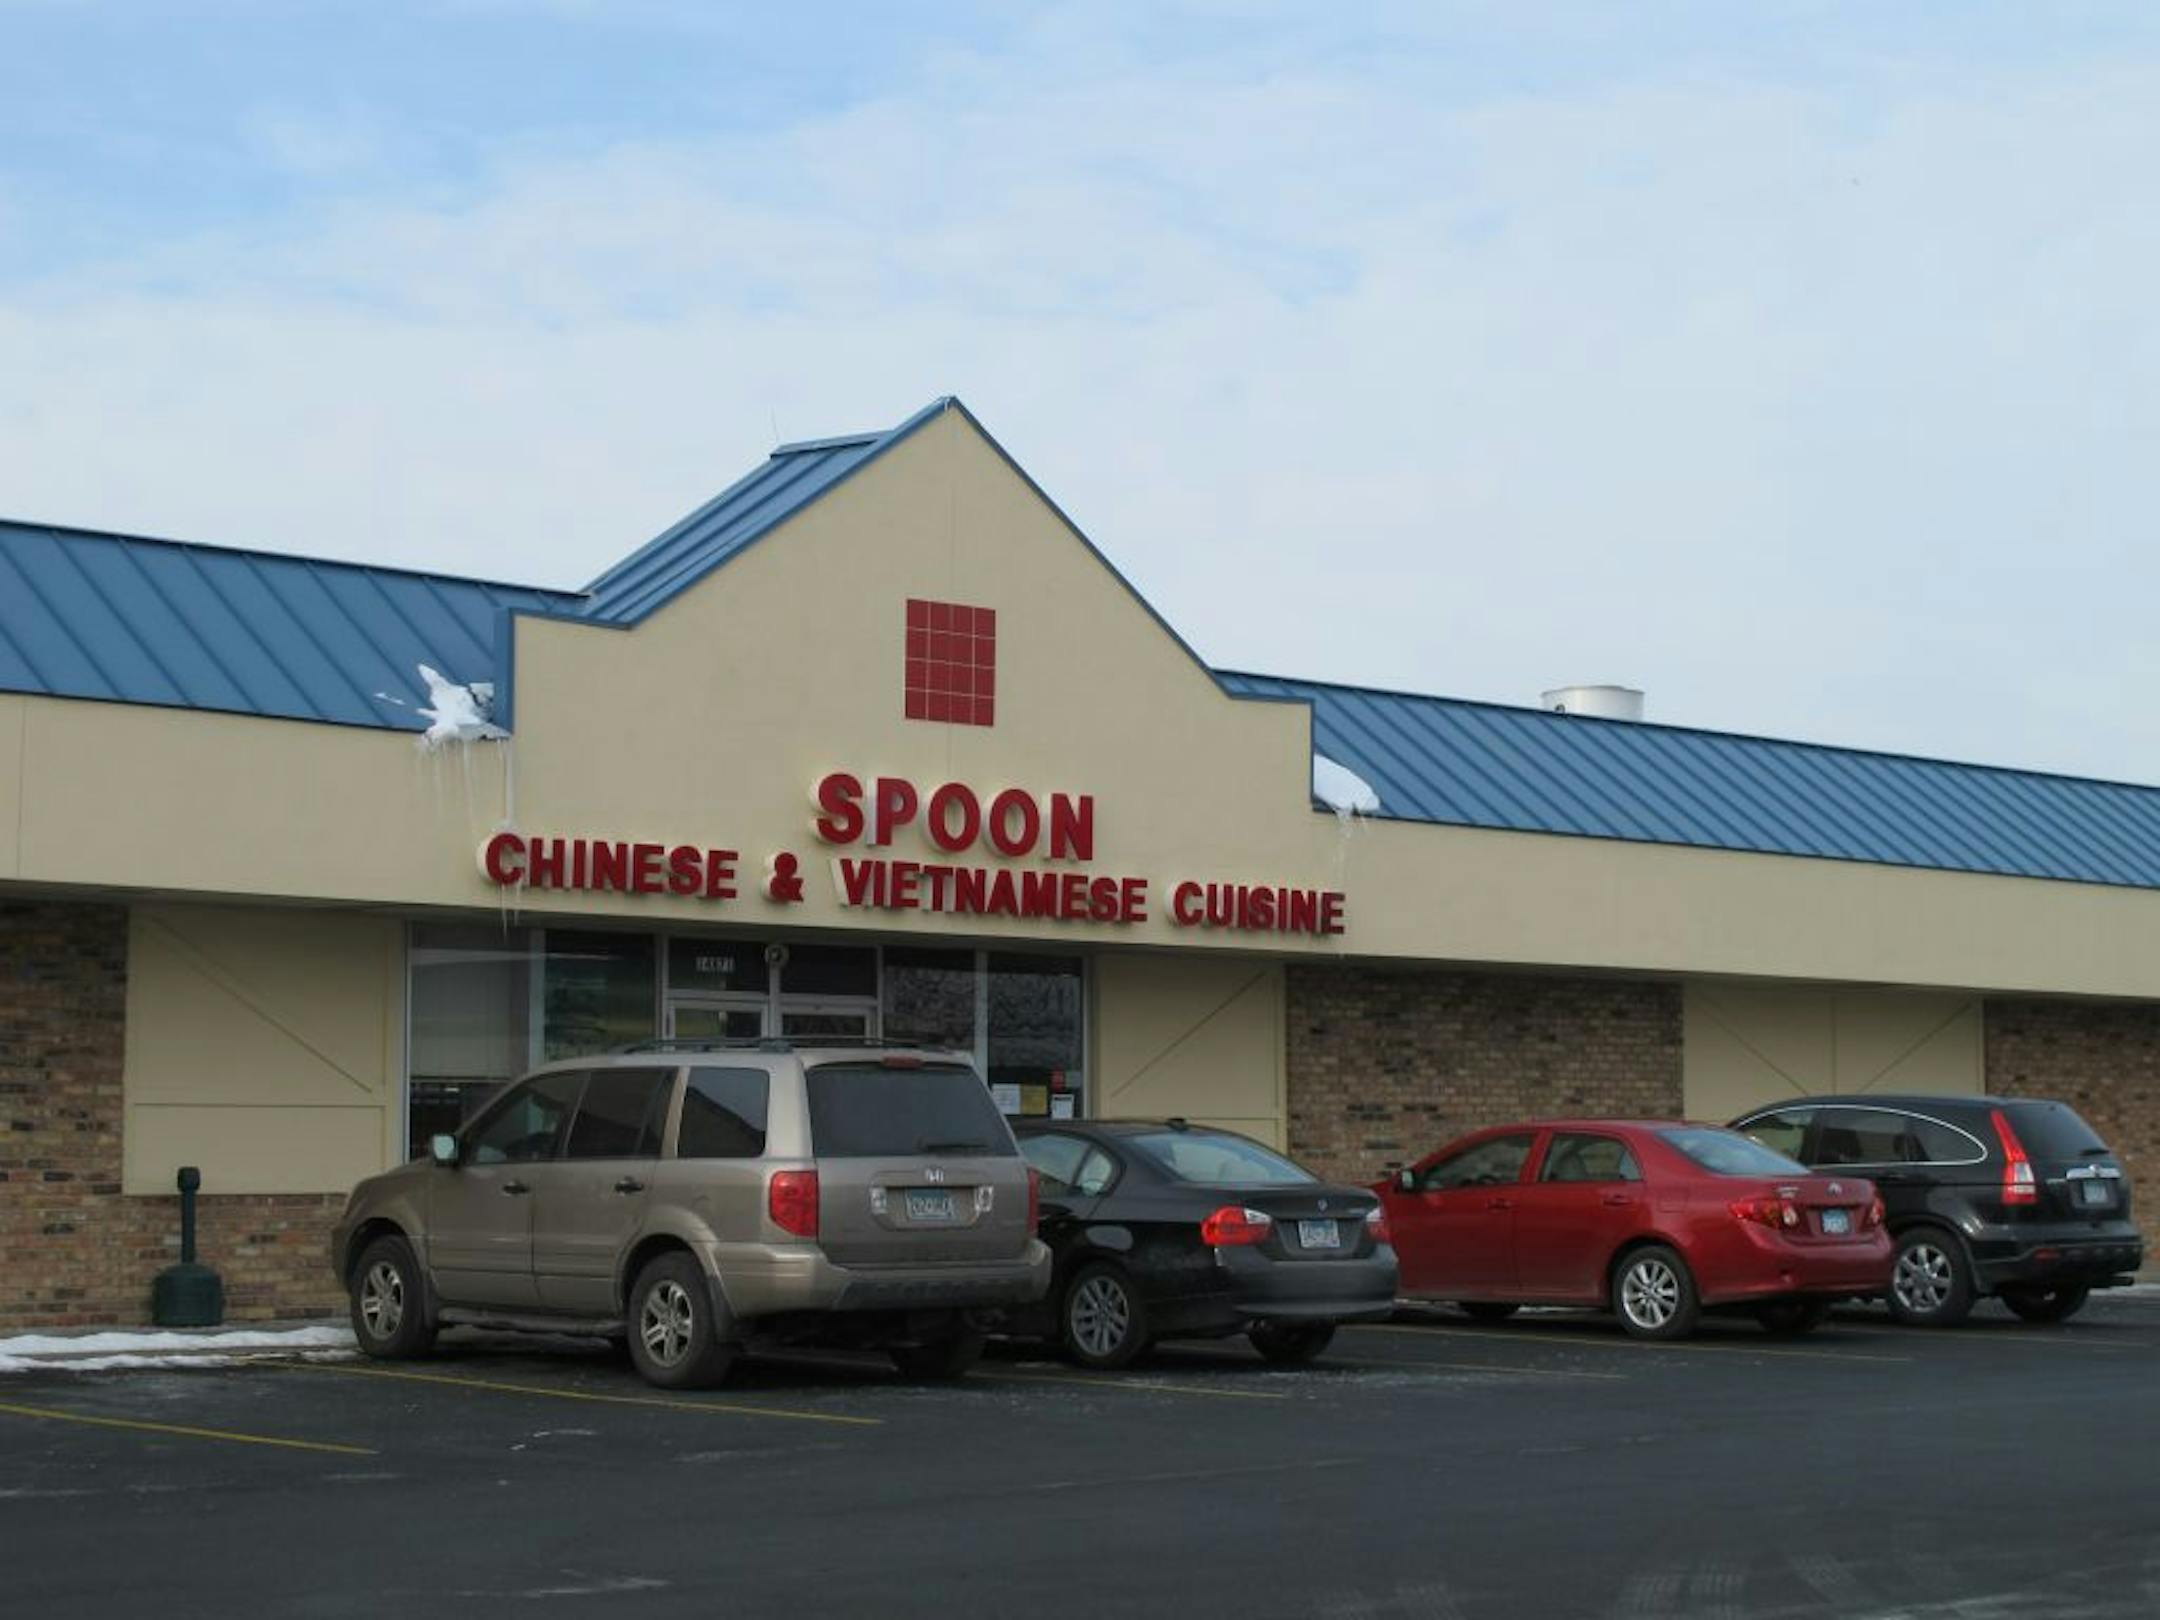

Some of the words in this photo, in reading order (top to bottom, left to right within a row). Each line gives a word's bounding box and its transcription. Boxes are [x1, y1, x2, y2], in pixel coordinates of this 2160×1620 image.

[816, 773, 1095, 860] SPOON
[486, 832, 738, 899] CHINESE
[770, 852, 803, 901] &
[843, 858, 1148, 923] VIETNAMESE
[1174, 881, 1346, 934] CUISINE
